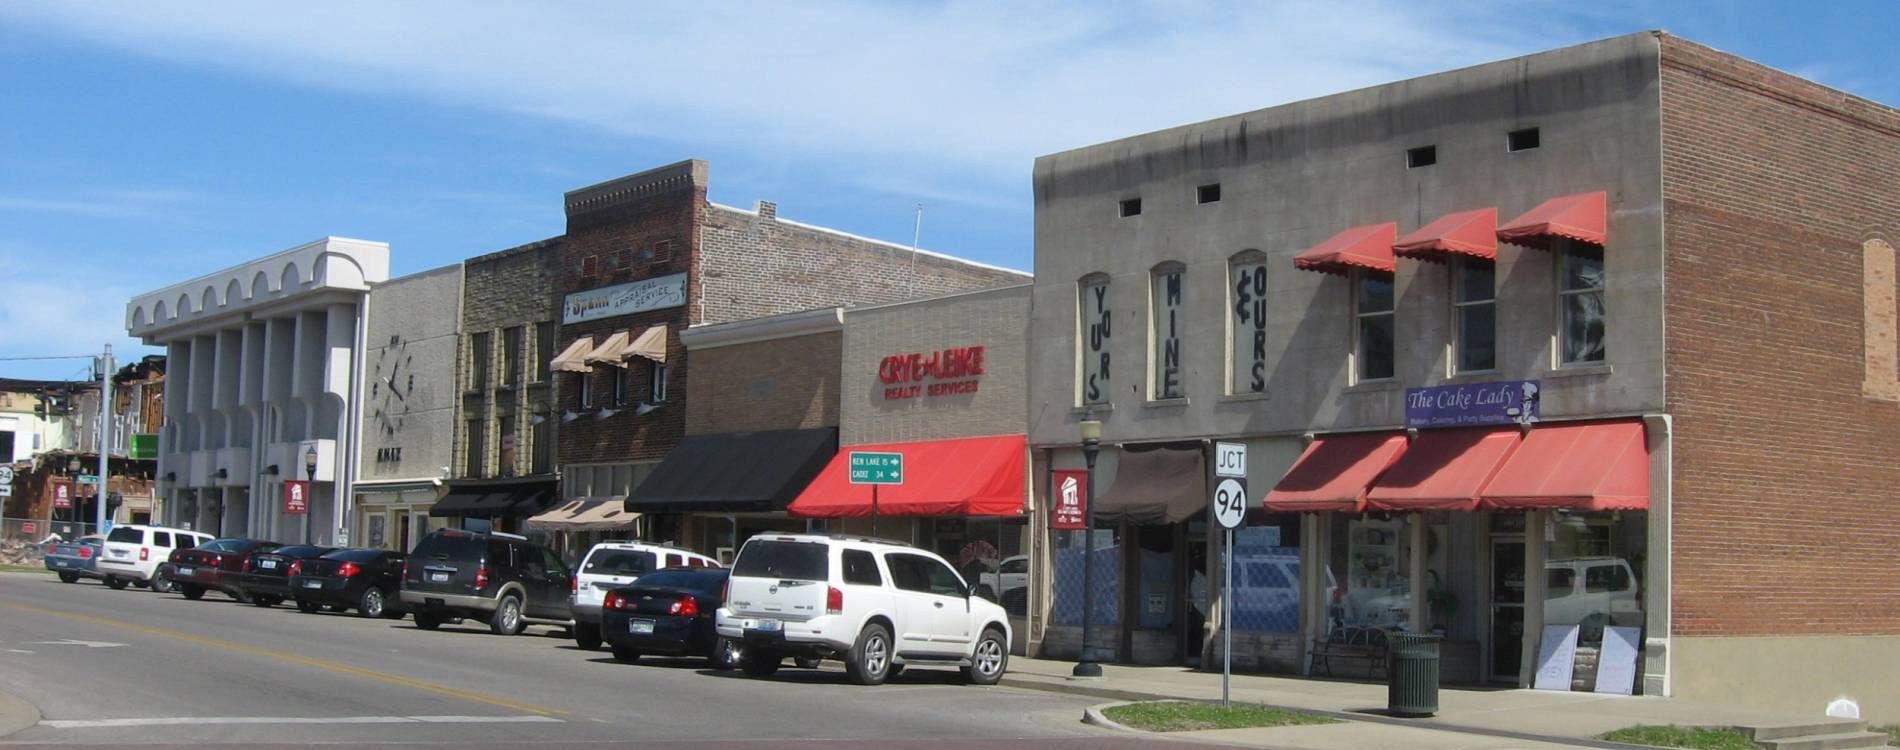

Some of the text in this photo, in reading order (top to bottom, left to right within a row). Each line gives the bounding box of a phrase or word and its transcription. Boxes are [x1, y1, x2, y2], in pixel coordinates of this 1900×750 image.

[615, 281, 657, 307] APPRAISAL
[636, 286, 668, 307] SERVICE
[1164, 273, 1181, 398] MINE
[1251, 266, 1267, 392] OURS
[884, 380, 978, 400] REALTY SERVICES
[1408, 384, 1514, 410] The Cake Lady
[866, 457, 880, 466] LAKE
[882, 458, 888, 466] 15
[1219, 450, 1244, 469] JCT
[852, 470, 884, 478] CADIZ 34
[1217, 488, 1243, 518] 94
